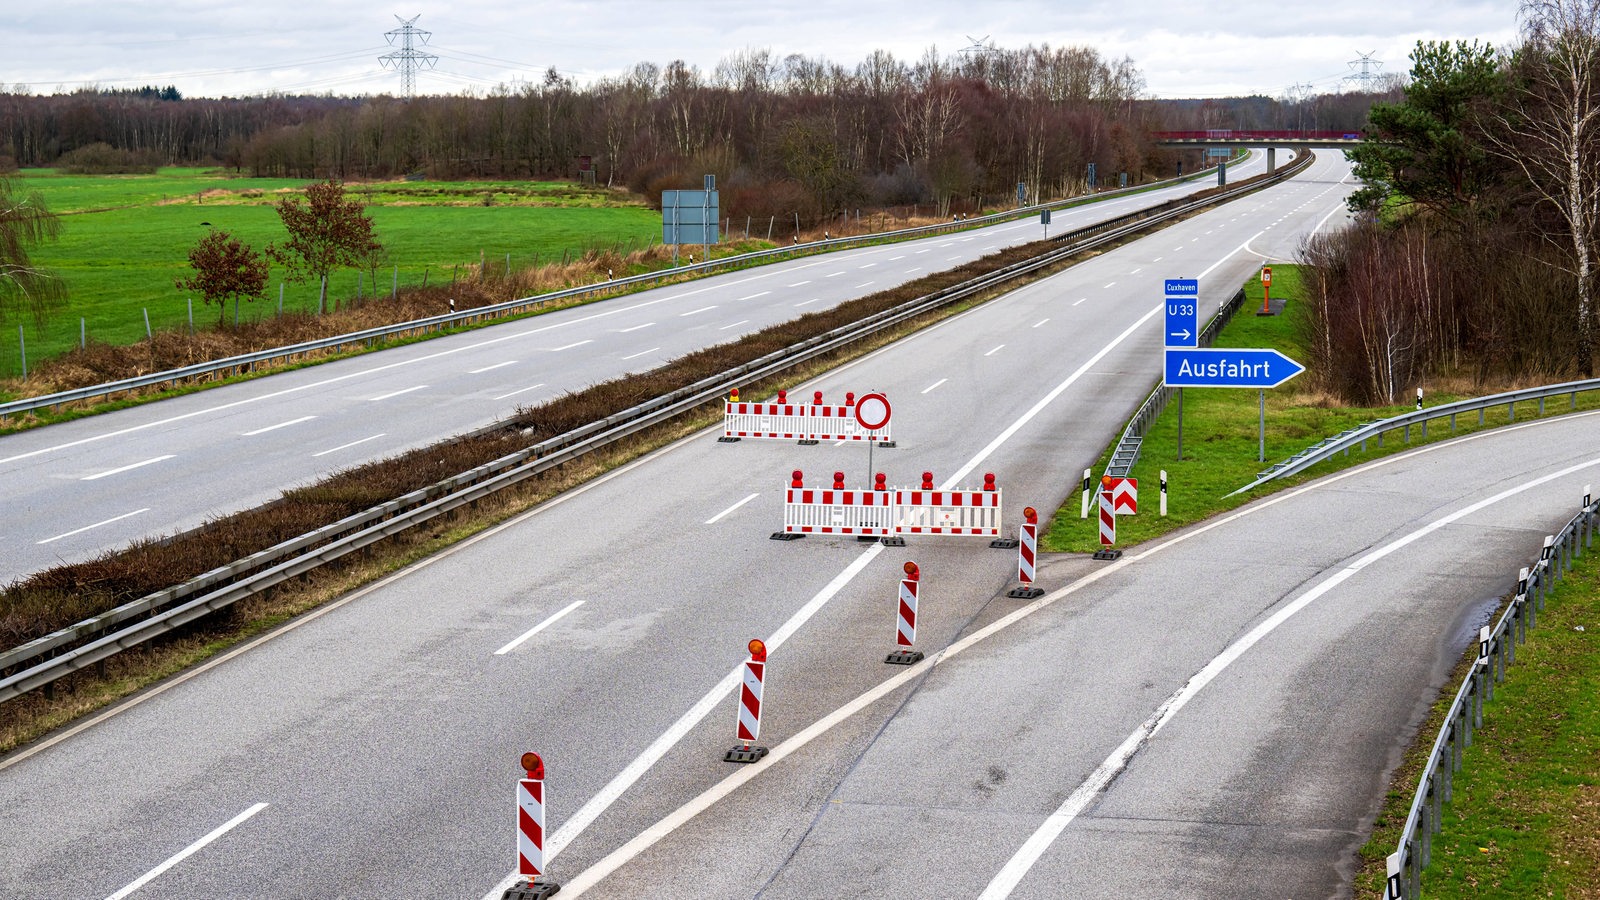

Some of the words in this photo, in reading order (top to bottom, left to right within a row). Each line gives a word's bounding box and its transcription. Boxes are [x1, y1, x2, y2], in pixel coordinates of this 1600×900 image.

[1167, 283, 1196, 291] Cuxhaven
[1168, 304, 1178, 316] U
[1179, 304, 1194, 316] 33
[1178, 358, 1270, 378] Ausfahrt
